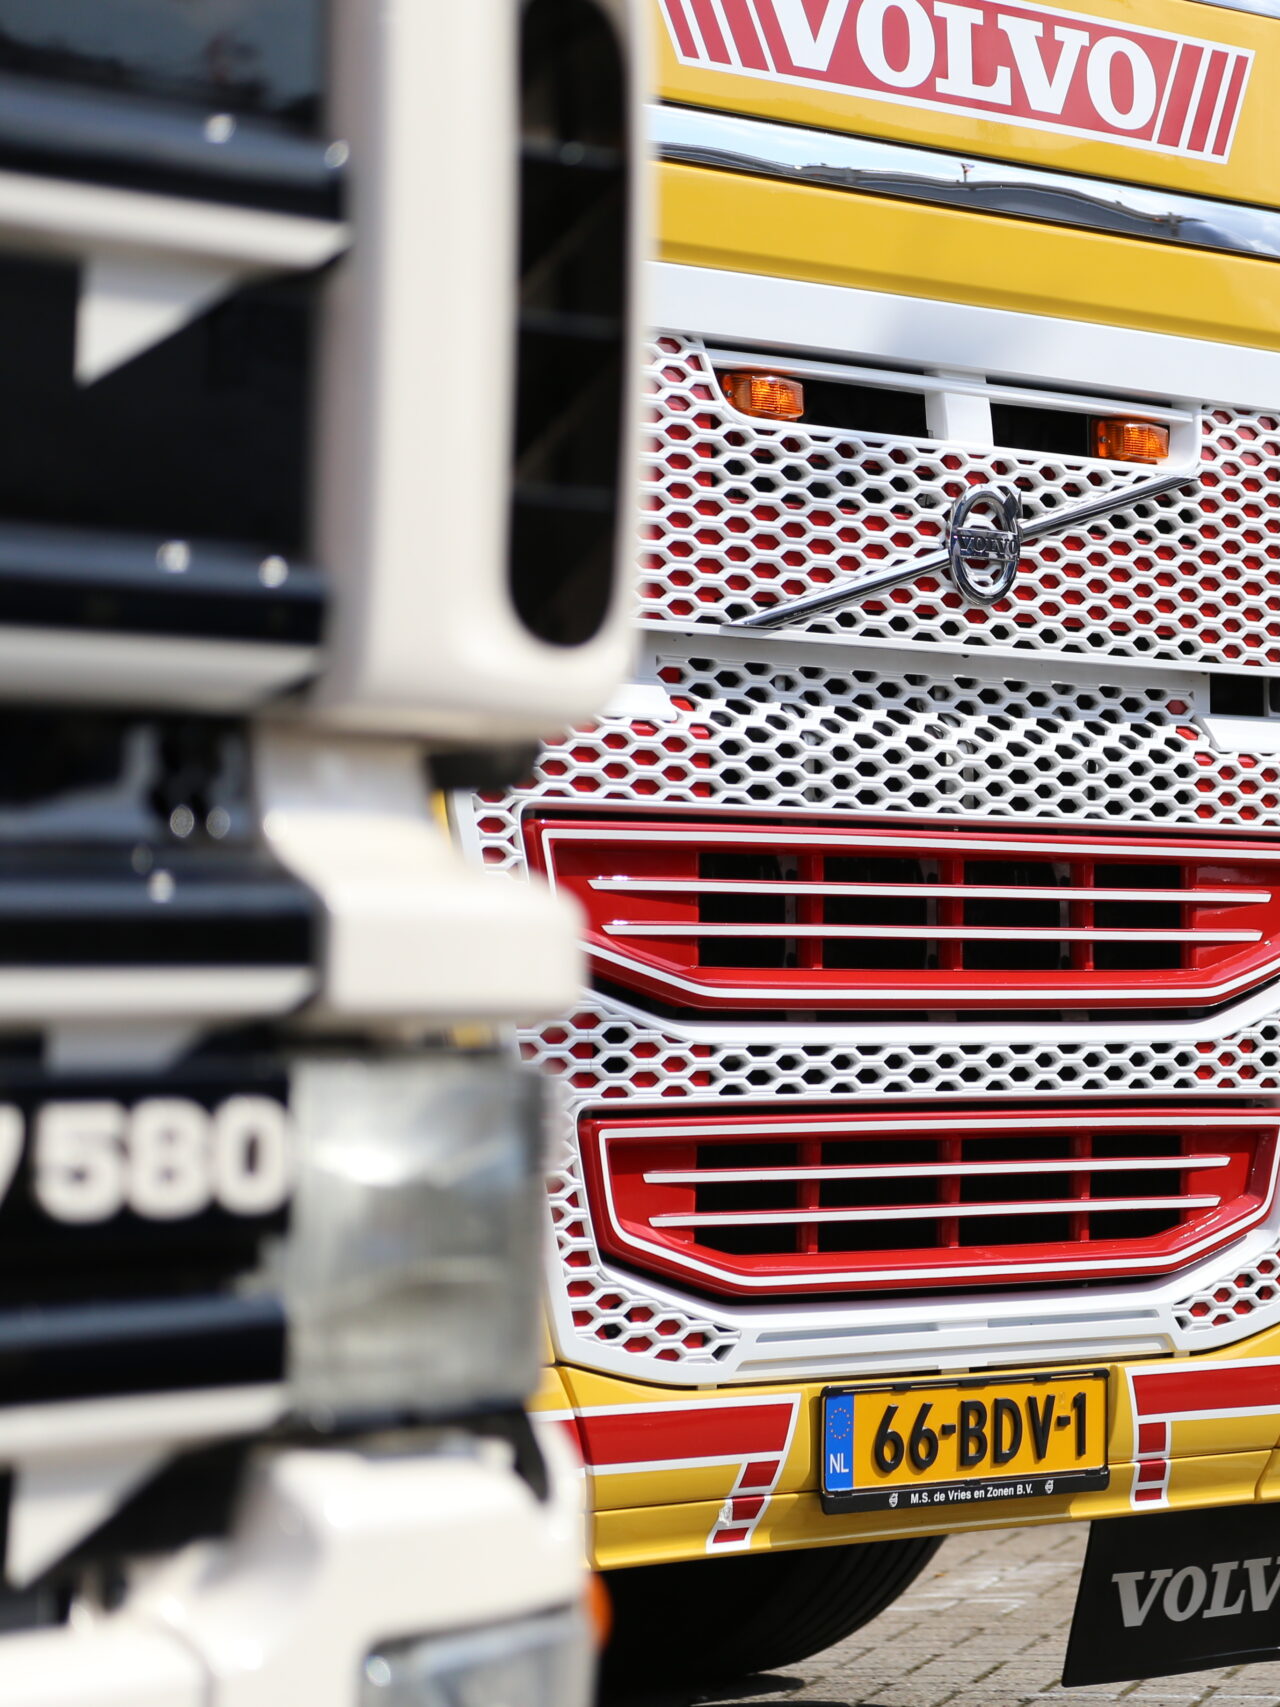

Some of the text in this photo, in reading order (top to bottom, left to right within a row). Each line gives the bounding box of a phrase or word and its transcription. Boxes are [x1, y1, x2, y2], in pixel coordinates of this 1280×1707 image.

[771, 0, 1158, 131] VOLVO
[958, 535, 1019, 555] VOLVO
[873, 1391, 1087, 1474] 66-BDV-1
[829, 1453, 850, 1475] NL
[910, 1483, 1033, 1504] M.S. de Vries en Zonen B.V.
